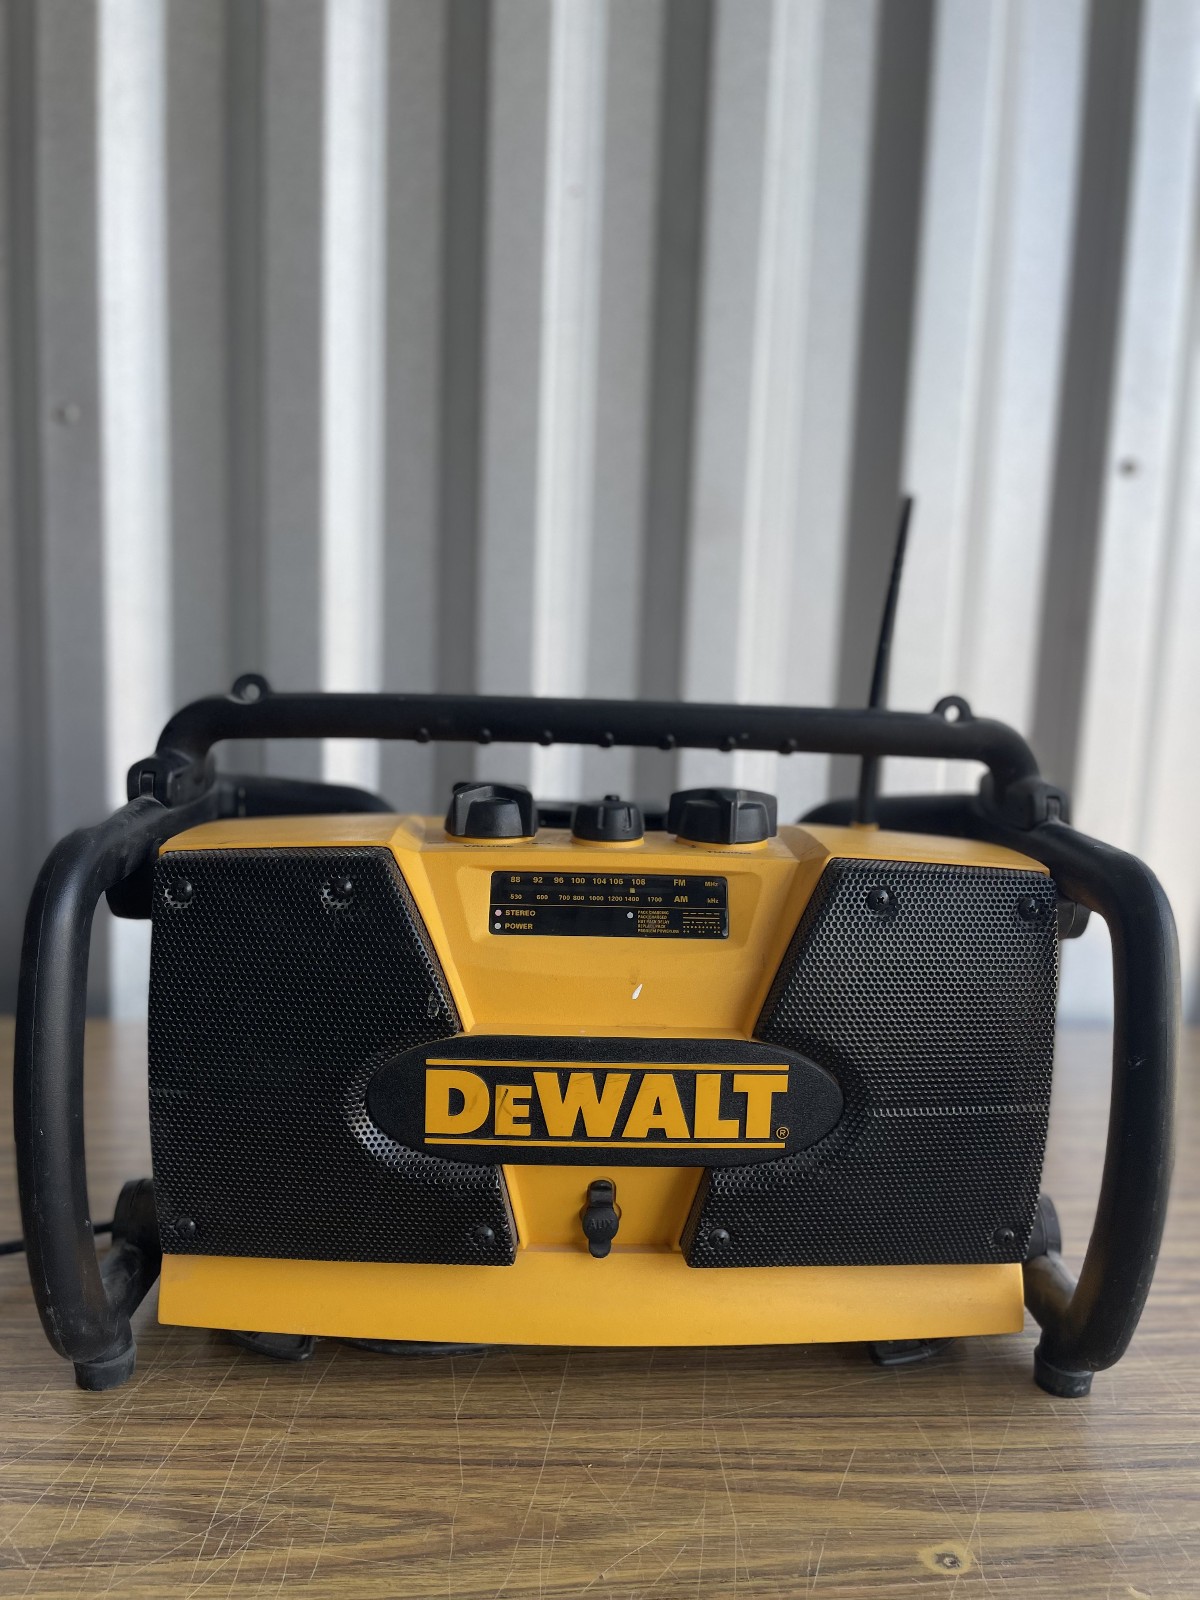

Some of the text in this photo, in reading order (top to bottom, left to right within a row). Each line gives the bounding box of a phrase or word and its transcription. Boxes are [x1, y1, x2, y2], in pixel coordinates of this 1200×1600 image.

[532, 876, 543, 884] 92
[673, 879, 686, 887] FM
[673, 895, 689, 903] AM
[505, 909, 536, 917] STEREO
[425, 1068, 789, 1139] DEWALT
[588, 1217, 614, 1231] AUX
